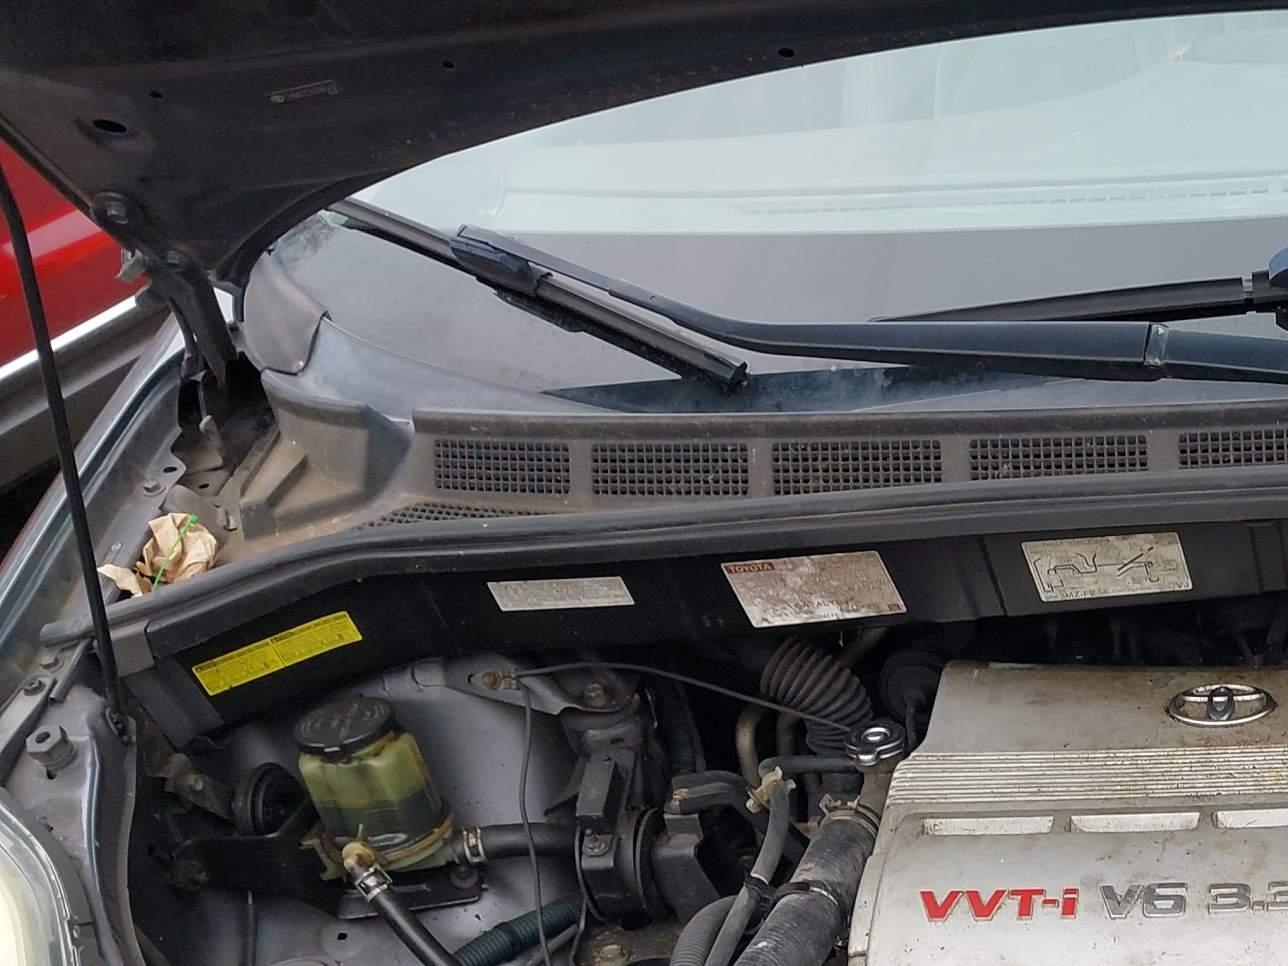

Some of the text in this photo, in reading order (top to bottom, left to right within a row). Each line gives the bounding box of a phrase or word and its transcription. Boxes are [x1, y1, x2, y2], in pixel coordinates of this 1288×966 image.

[729, 562, 776, 574] TOYOTA
[919, 887, 1079, 921] VVT-i
[1098, 882, 1189, 920] V6
